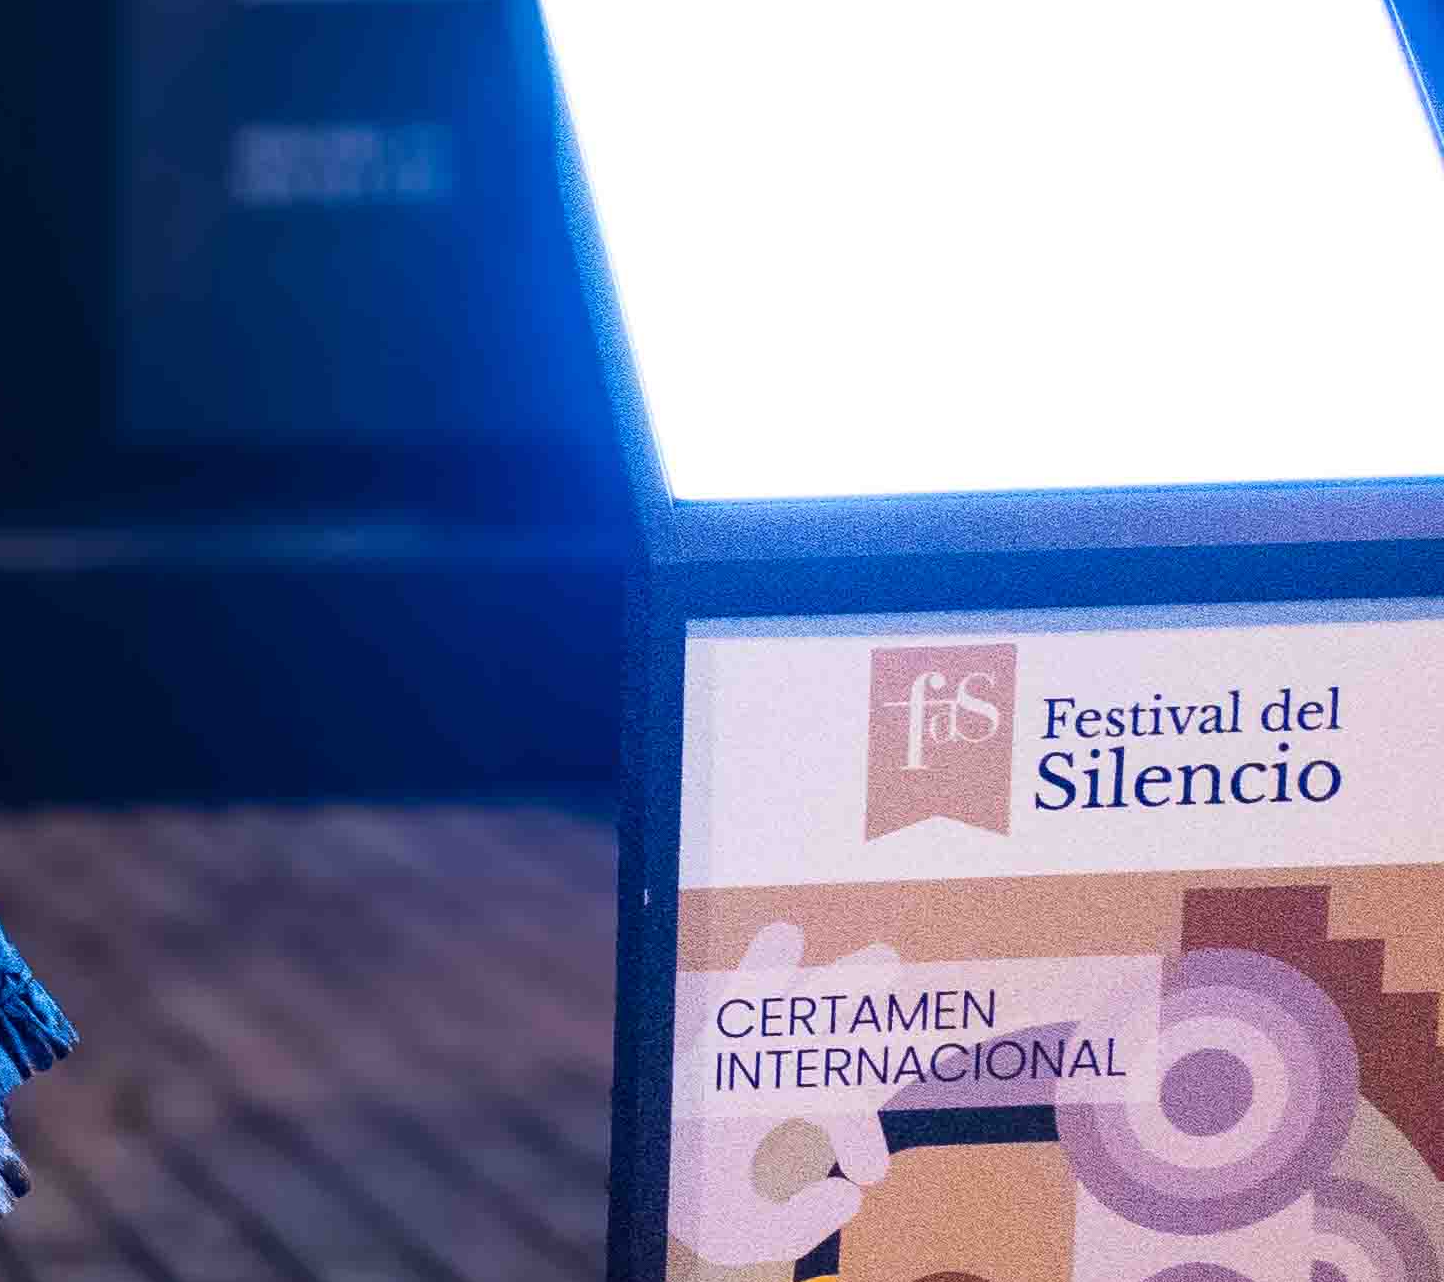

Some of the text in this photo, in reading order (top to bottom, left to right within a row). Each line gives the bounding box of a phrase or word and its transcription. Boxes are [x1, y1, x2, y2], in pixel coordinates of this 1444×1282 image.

[1042, 687, 1342, 739] Festival del
[1035, 743, 1342, 811] Silencio
[716, 989, 995, 1038] CERTAMEN
[716, 1037, 1126, 1091] INTERNACIONAL
